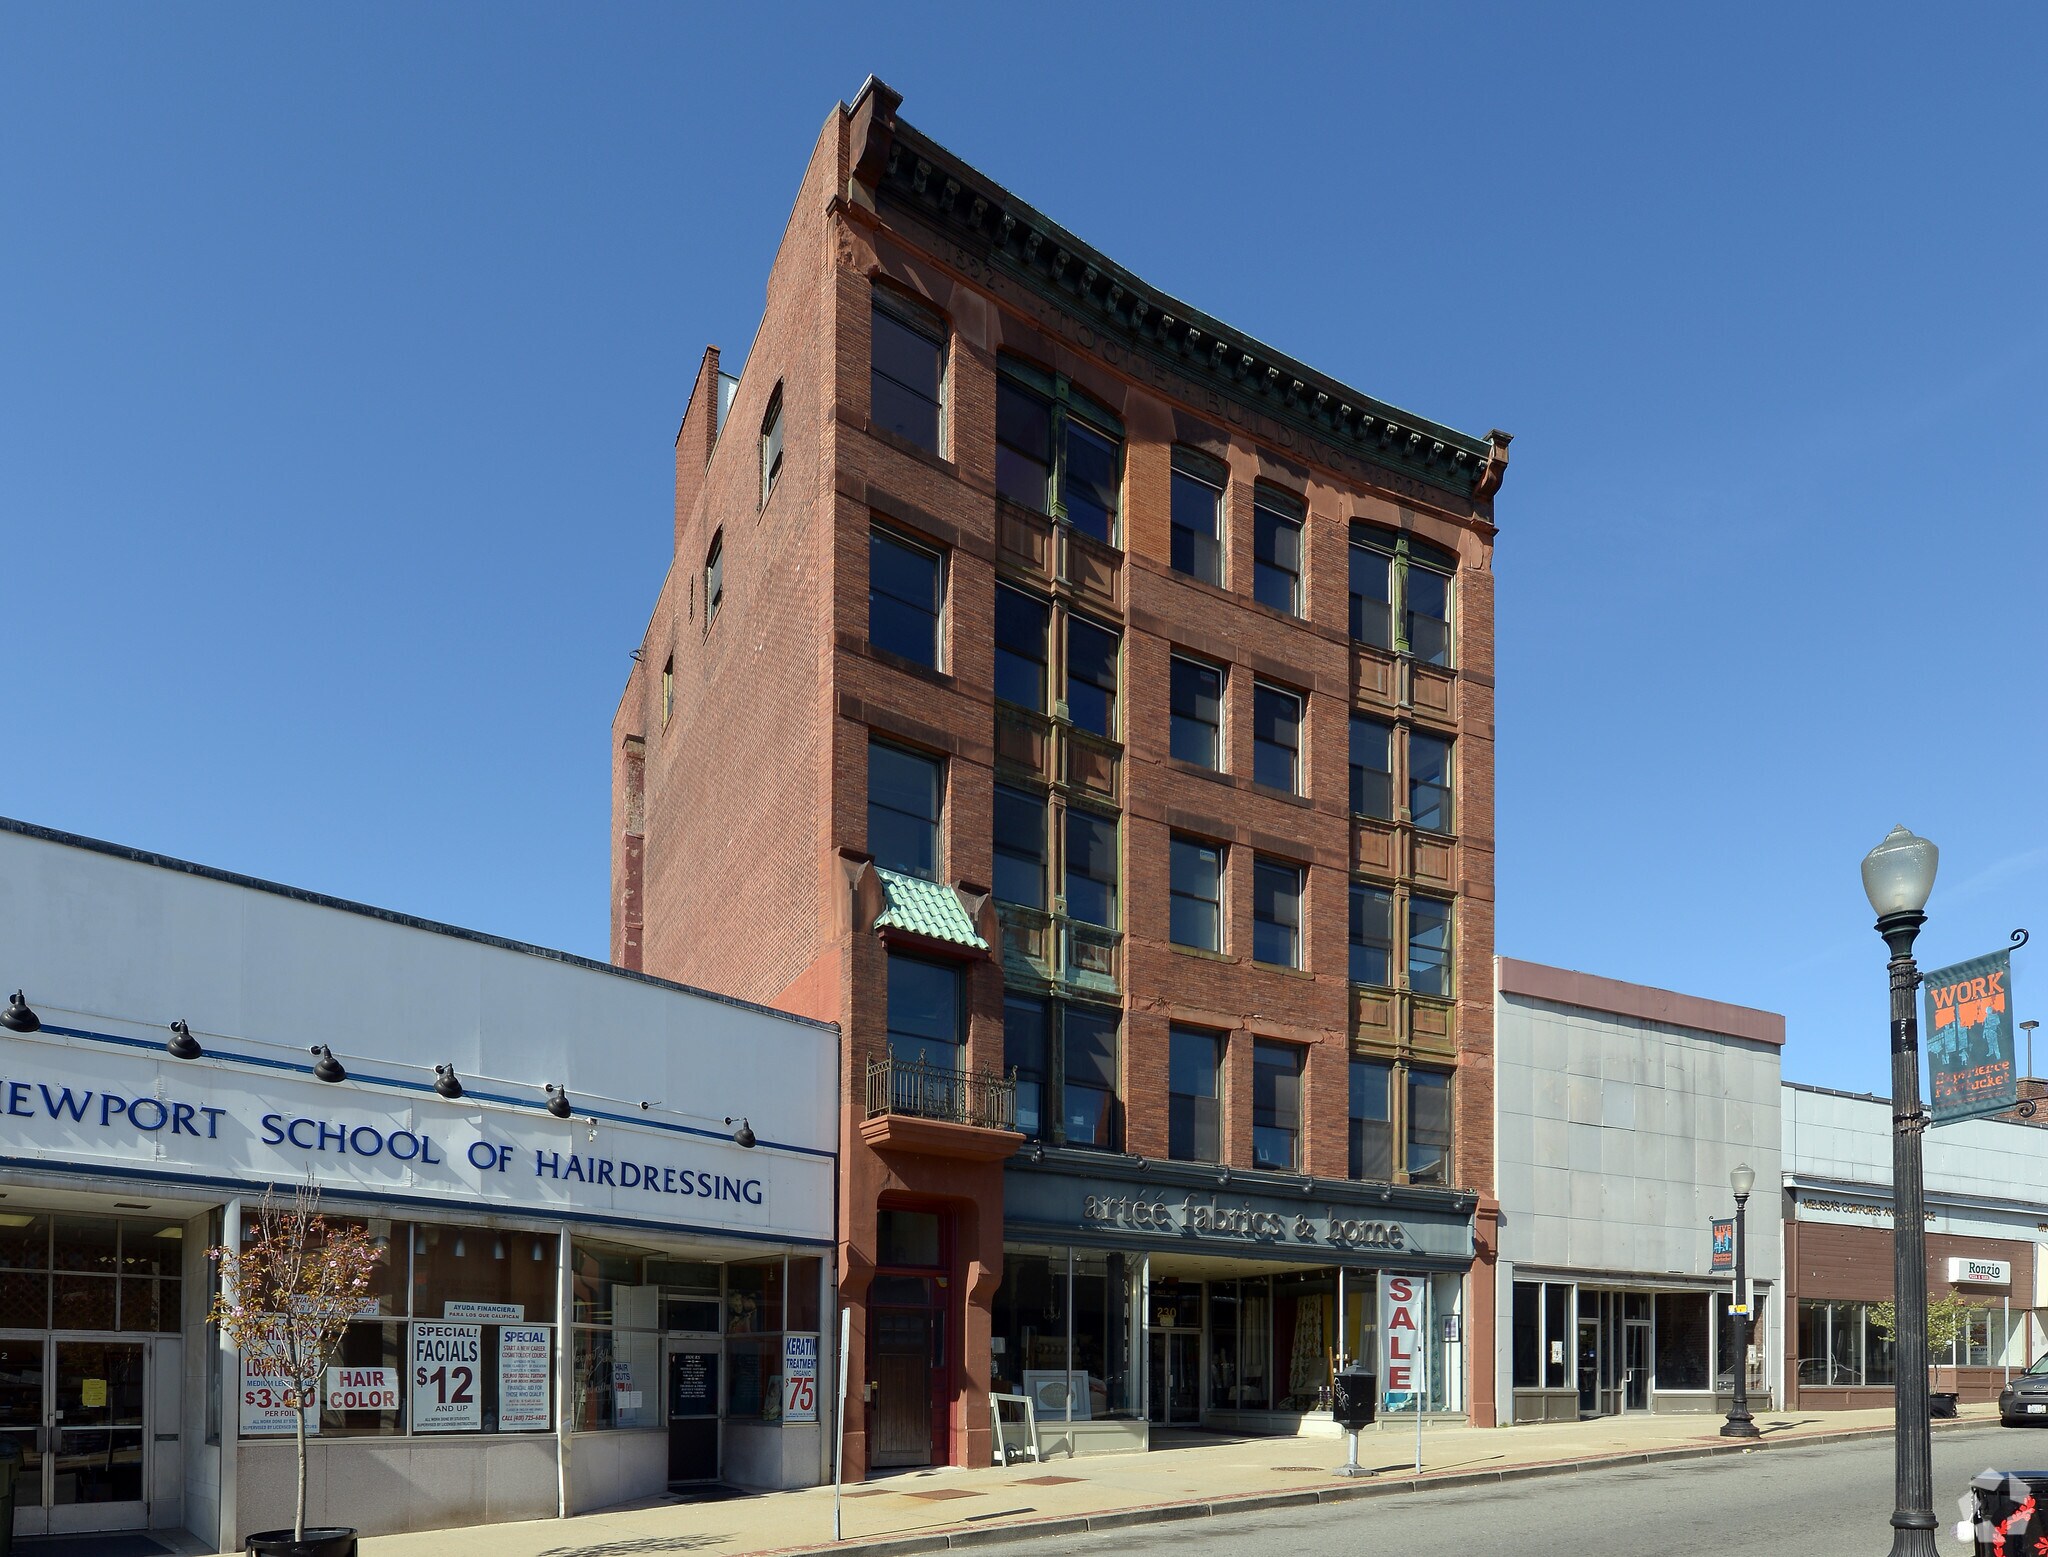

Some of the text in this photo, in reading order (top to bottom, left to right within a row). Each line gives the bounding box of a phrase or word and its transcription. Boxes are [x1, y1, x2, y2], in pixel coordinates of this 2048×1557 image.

[1049, 306, 1344, 472] TOOLE BUILDING
[1931, 972, 2004, 1009] WORK
[261, 1114, 441, 1165] SCHOOL
[467, 1141, 514, 1173] OF
[535, 1150, 762, 1204] HAIRDRESSING
[1083, 1188, 1404, 1245] artéé fabrics & home
[1802, 1198, 1840, 1214] MELISSA'S
[1884, 1207, 1895, 1217] AN
[1714, 1224, 1732, 1232] LIVE
[1968, 1261, 2001, 1278] Ronzio
[477, 1305, 516, 1313] FINANCIERA
[1157, 1307, 1177, 1318] 230
[418, 1326, 477, 1338] SPECIAL!
[504, 1331, 545, 1343] SPECIAL
[1388, 1277, 1416, 1390] SALE
[416, 1339, 478, 1362] FACIALS
[786, 1337, 817, 1355] KERATIN
[614, 1363, 628, 1372] HAIR
[786, 1358, 817, 1369] TREATMENT
[339, 1371, 386, 1387] HAIR
[416, 1365, 473, 1404] $12
[614, 1372, 631, 1381] CUTS
[245, 1388, 316, 1409] $3.00
[330, 1391, 396, 1409] COLOR
[785, 1377, 815, 1411] $75
